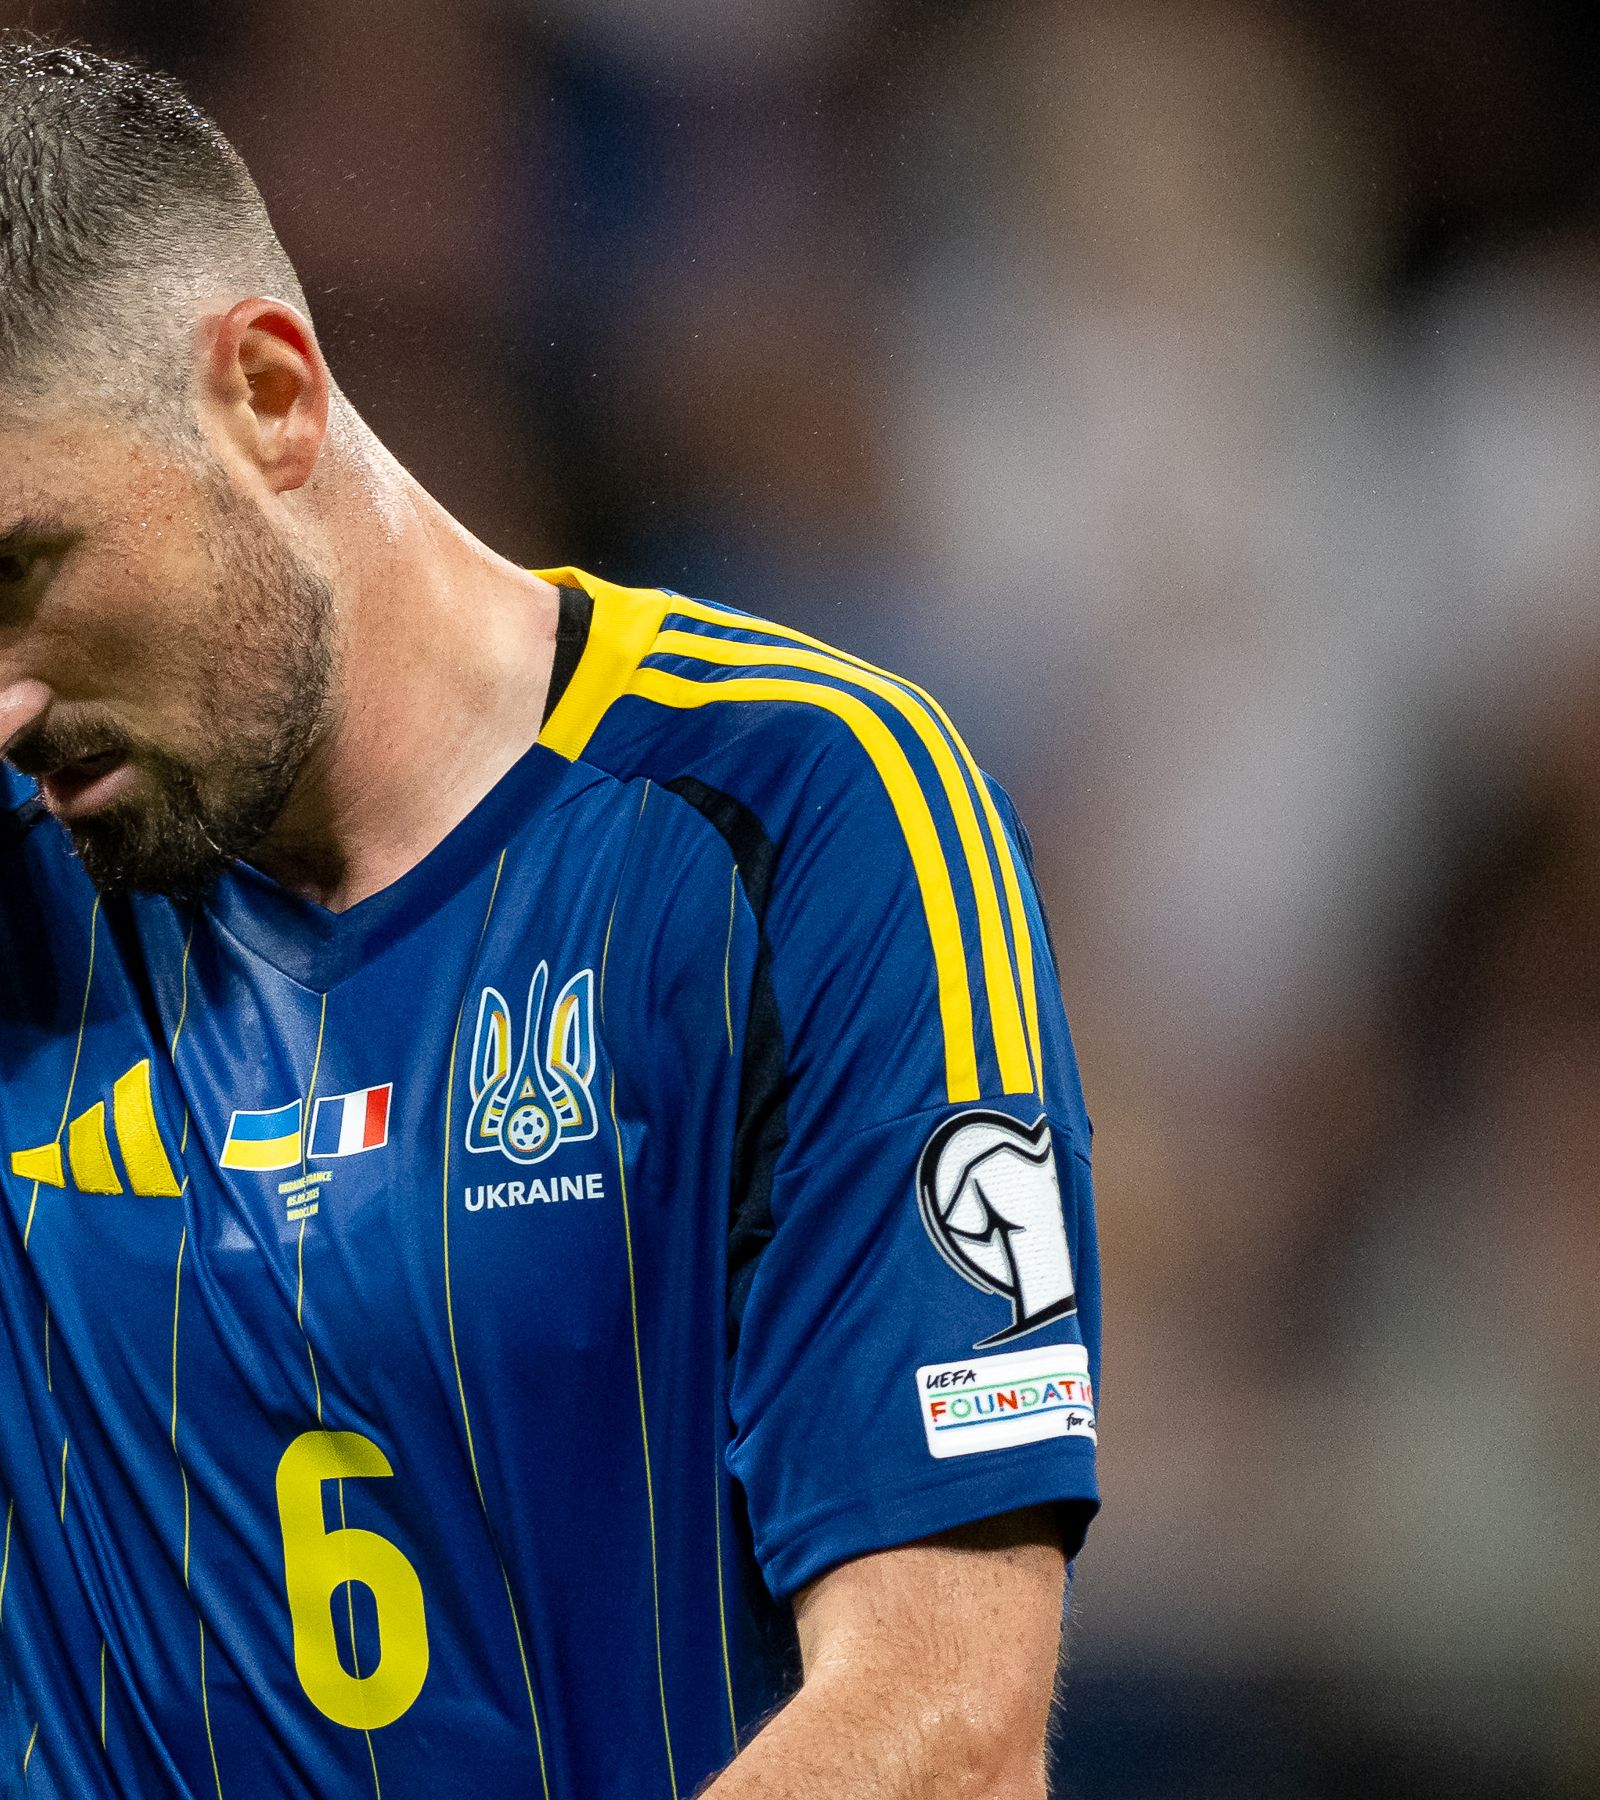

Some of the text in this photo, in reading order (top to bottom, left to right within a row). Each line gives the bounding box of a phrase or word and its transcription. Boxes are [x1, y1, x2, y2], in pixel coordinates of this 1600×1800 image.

[464, 1173, 605, 1212] UKRAINE
[926, 1369, 977, 1389] UEFA
[1066, 1412, 1085, 1431] for
[276, 1430, 429, 1730] 6
